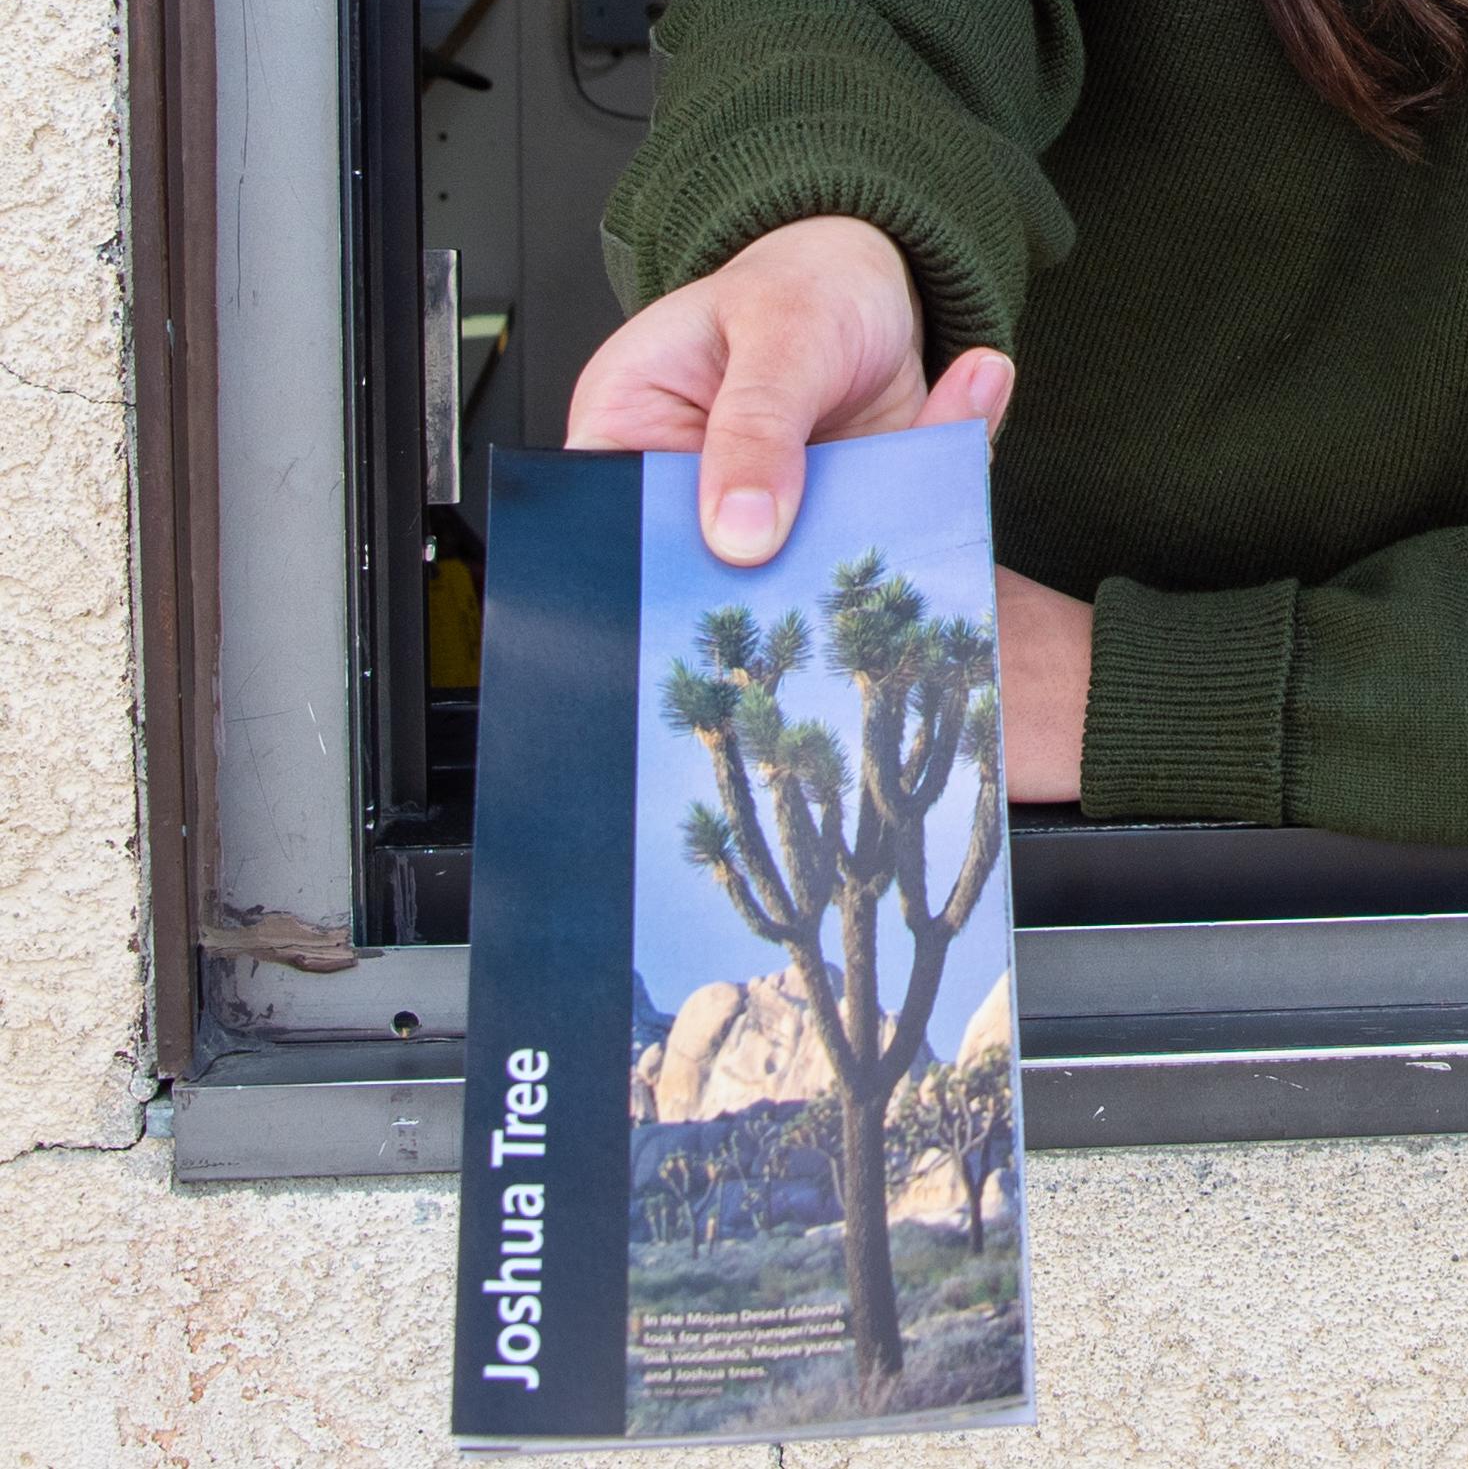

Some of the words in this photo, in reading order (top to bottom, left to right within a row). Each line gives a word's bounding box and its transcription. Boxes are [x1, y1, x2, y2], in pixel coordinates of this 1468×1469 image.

[490, 1048, 550, 1167] Tree
[483, 1183, 546, 1390] Joshua
[644, 1314, 658, 1327] In
[661, 1312, 684, 1327] the
[686, 1311, 738, 1328] Mojave
[740, 1308, 786, 1321] Desert
[644, 1330, 675, 1345] look
[679, 1330, 701, 1344] for
[644, 1349, 669, 1364] oak
[752, 1343, 802, 1359] Mojave
[644, 1368, 672, 1384] and
[675, 1366, 726, 1383] Joshua
[728, 1365, 768, 1380] trees.
